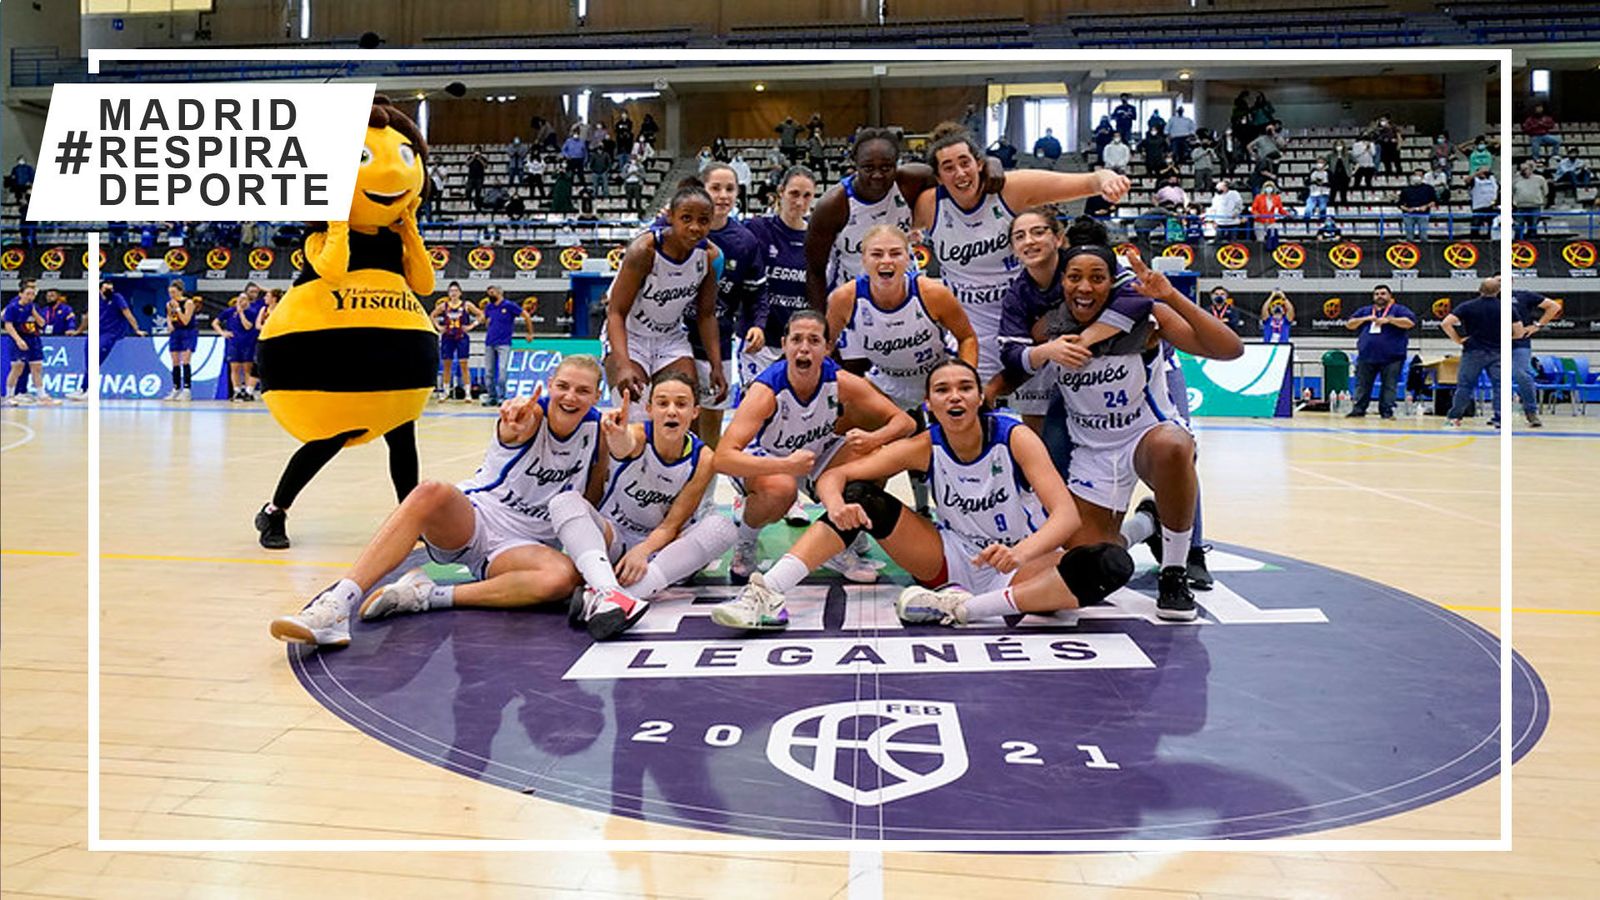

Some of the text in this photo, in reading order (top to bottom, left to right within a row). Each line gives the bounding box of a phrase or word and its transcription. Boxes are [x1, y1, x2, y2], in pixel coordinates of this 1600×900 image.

[331, 288, 424, 314] Ynsadie
[1103, 389, 1129, 408] 24
[993, 513, 1008, 532] 9
[628, 634, 1099, 672] LEGANÉS
[886, 703, 942, 716] FEB
